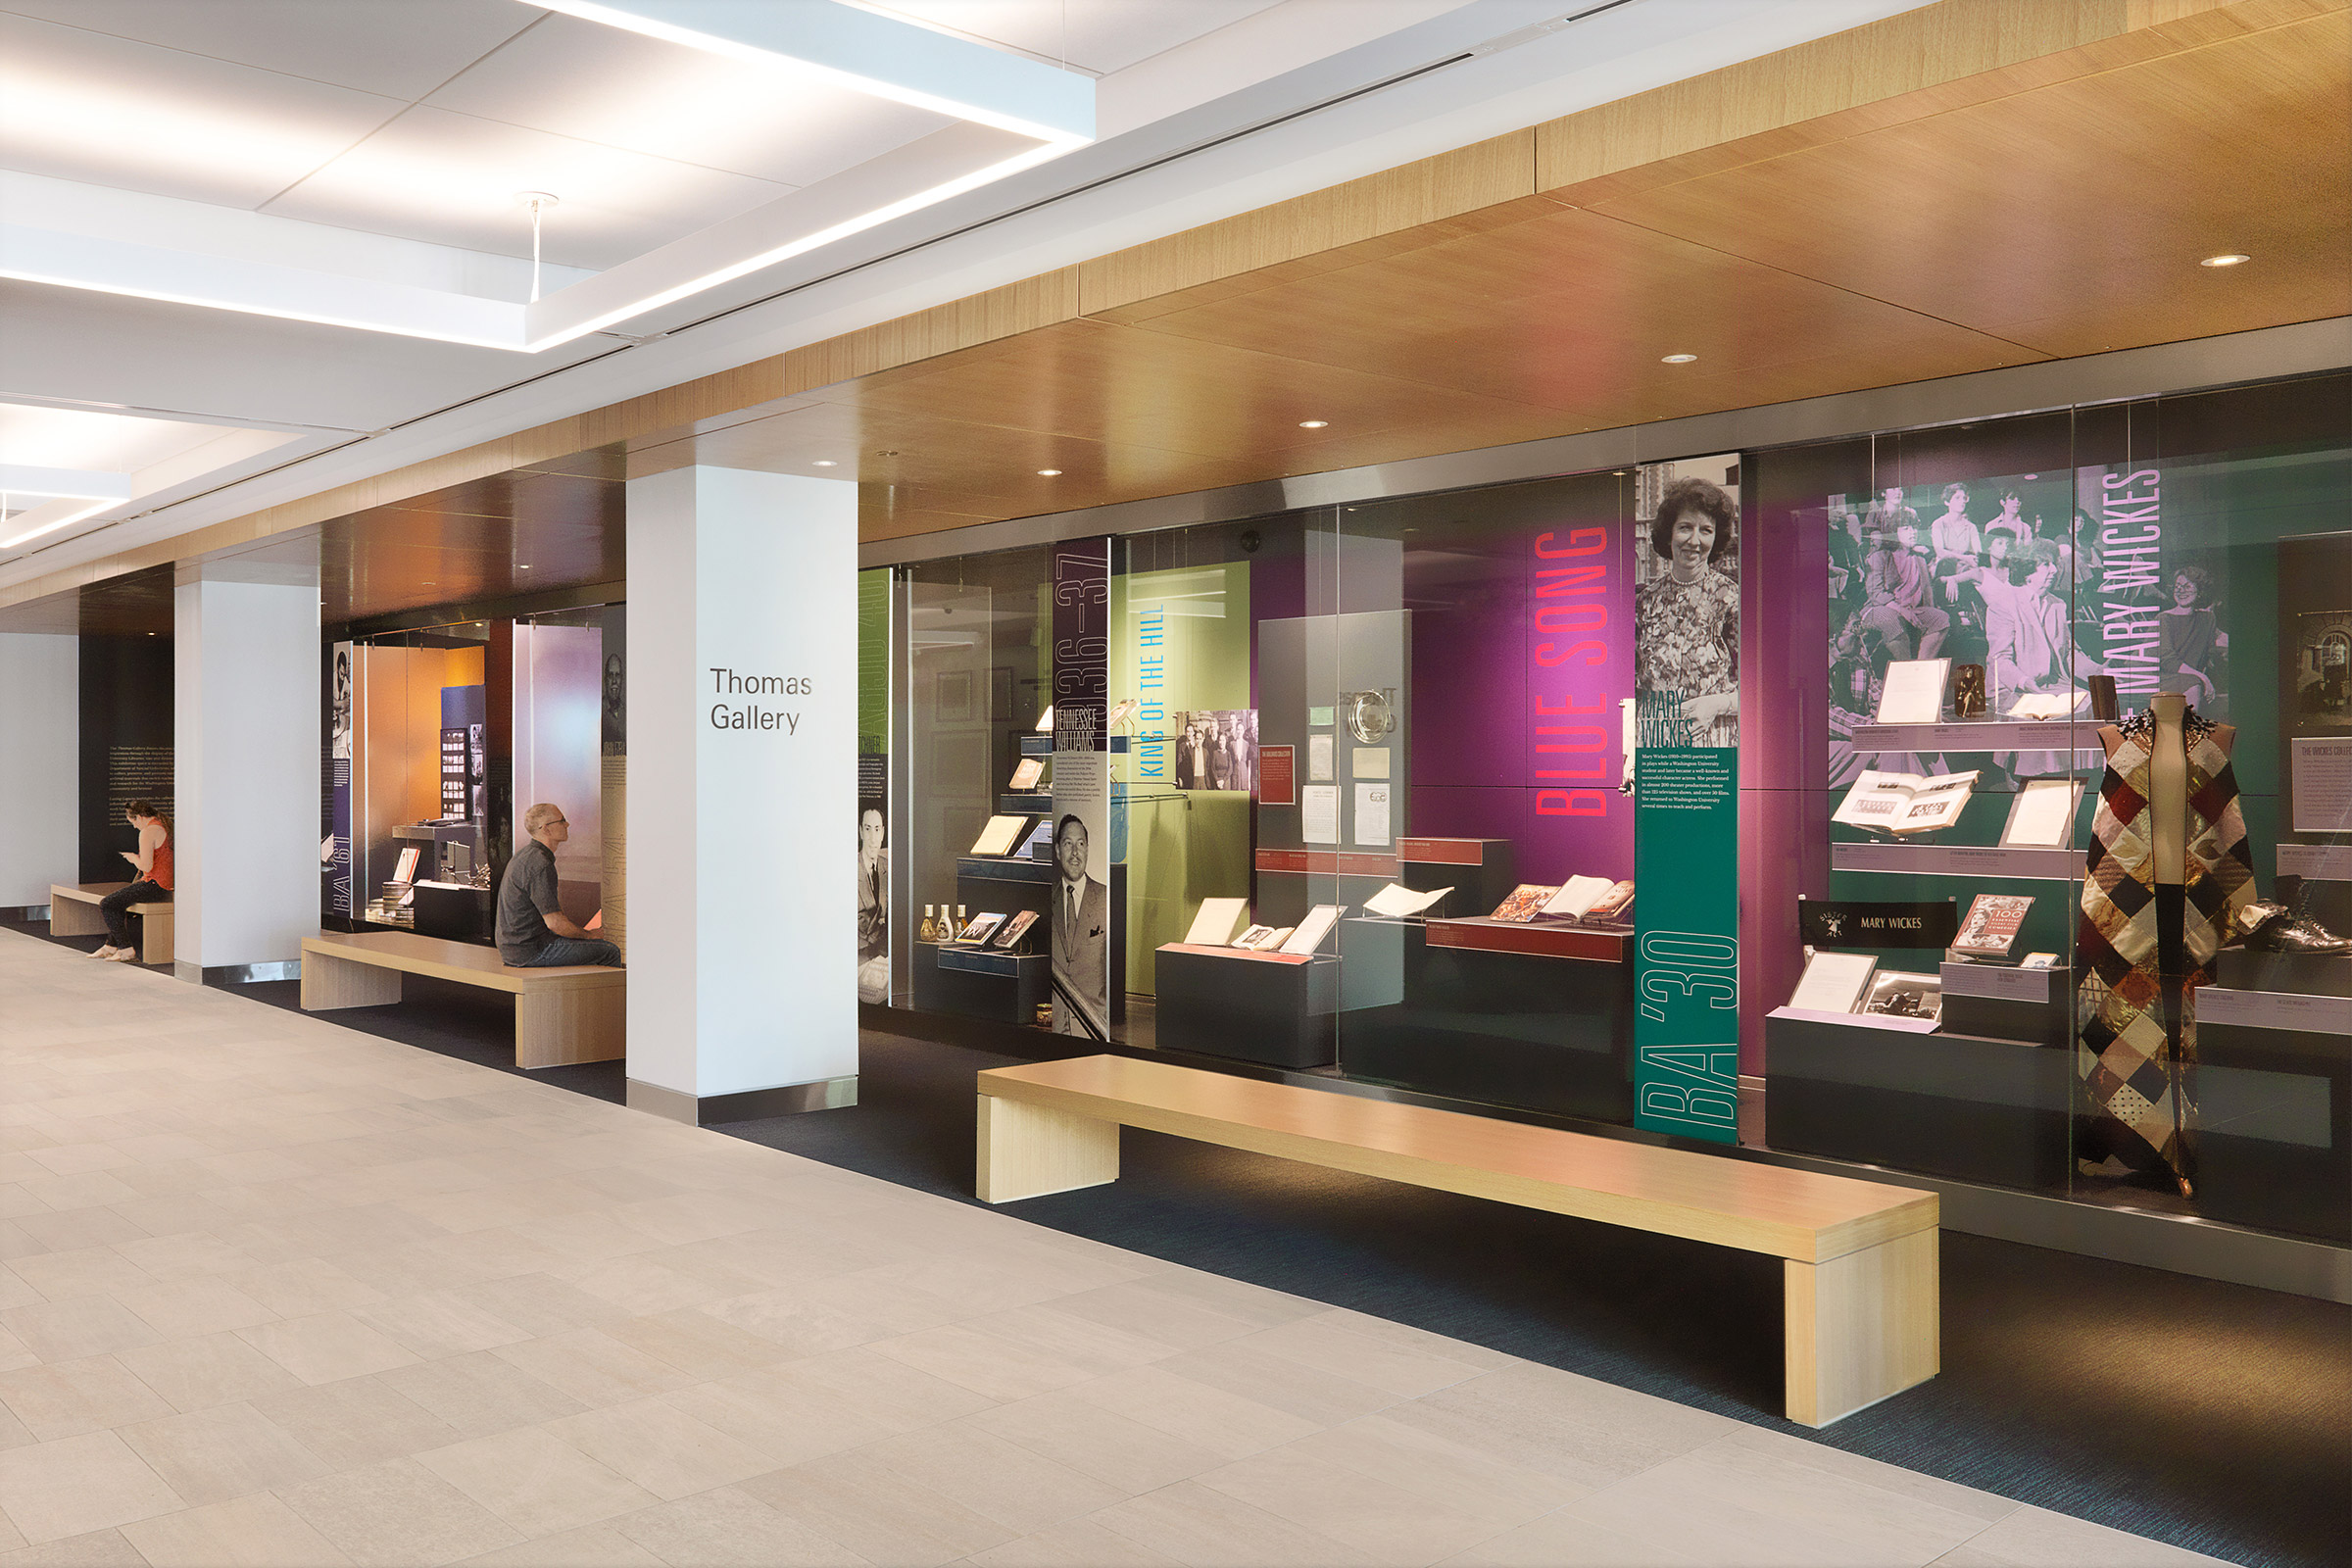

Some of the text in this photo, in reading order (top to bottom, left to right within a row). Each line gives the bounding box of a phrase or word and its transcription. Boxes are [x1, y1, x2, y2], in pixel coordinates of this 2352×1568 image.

[2102, 468, 2161, 694] MARY WICKES
[710, 668, 812, 695] Thomas
[1535, 526, 1607, 817] BLUE SONG
[1140, 604, 1164, 777] KING OF THE HILL
[1642, 690, 1685, 718] MARY
[710, 704, 800, 735] Gallery
[1055, 709, 1097, 730] TENNESSEE
[1642, 719, 1692, 748] WICKES
[1055, 730, 1095, 752] WILLIAMS
[332, 875, 351, 911] BA
[1860, 917, 1922, 929] MARY WICKES
[1641, 930, 1738, 1130] BA '30
